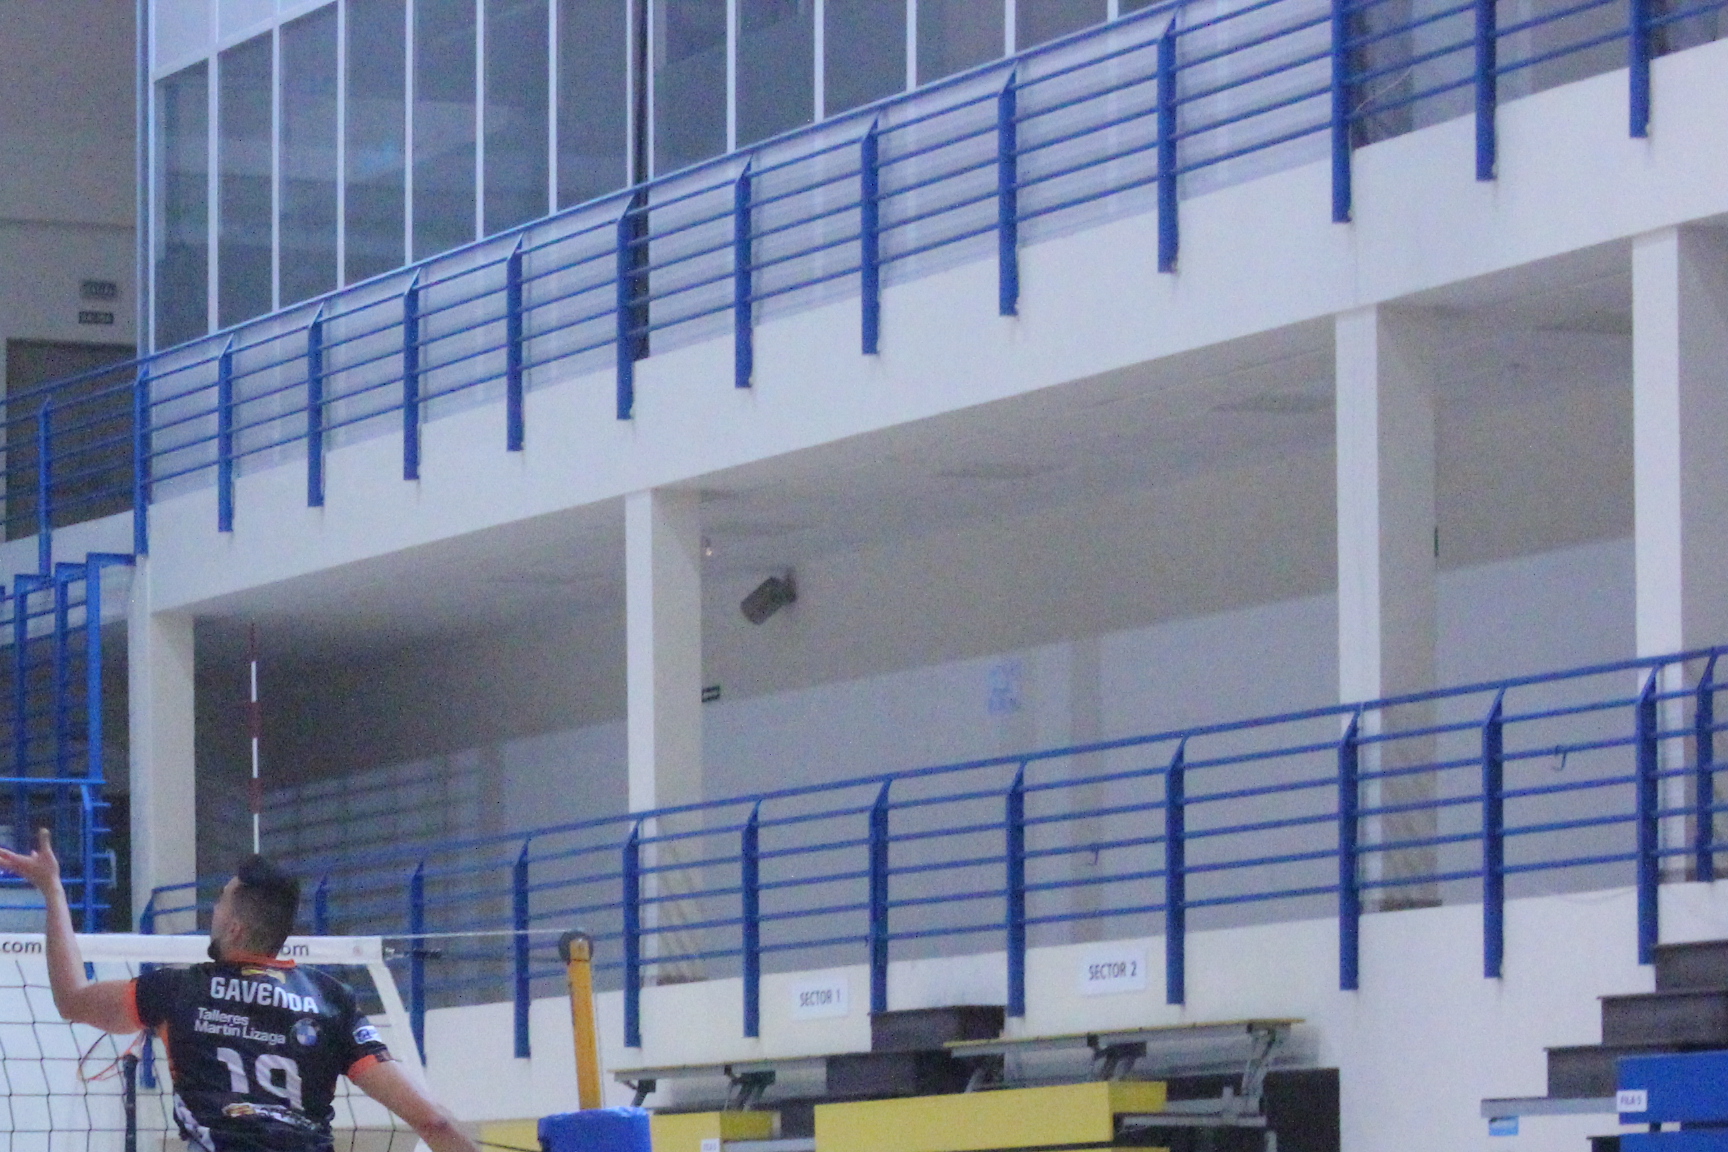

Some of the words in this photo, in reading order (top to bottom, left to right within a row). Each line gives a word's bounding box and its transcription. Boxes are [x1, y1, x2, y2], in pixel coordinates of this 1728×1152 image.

[1089, 962, 1127, 981] SECTOR
[1131, 964, 1137, 977] 2
[800, 990, 832, 1007] SECTOR
[197, 1007, 249, 1026] Talleres
[242, 1025, 286, 1046] Lizaga
